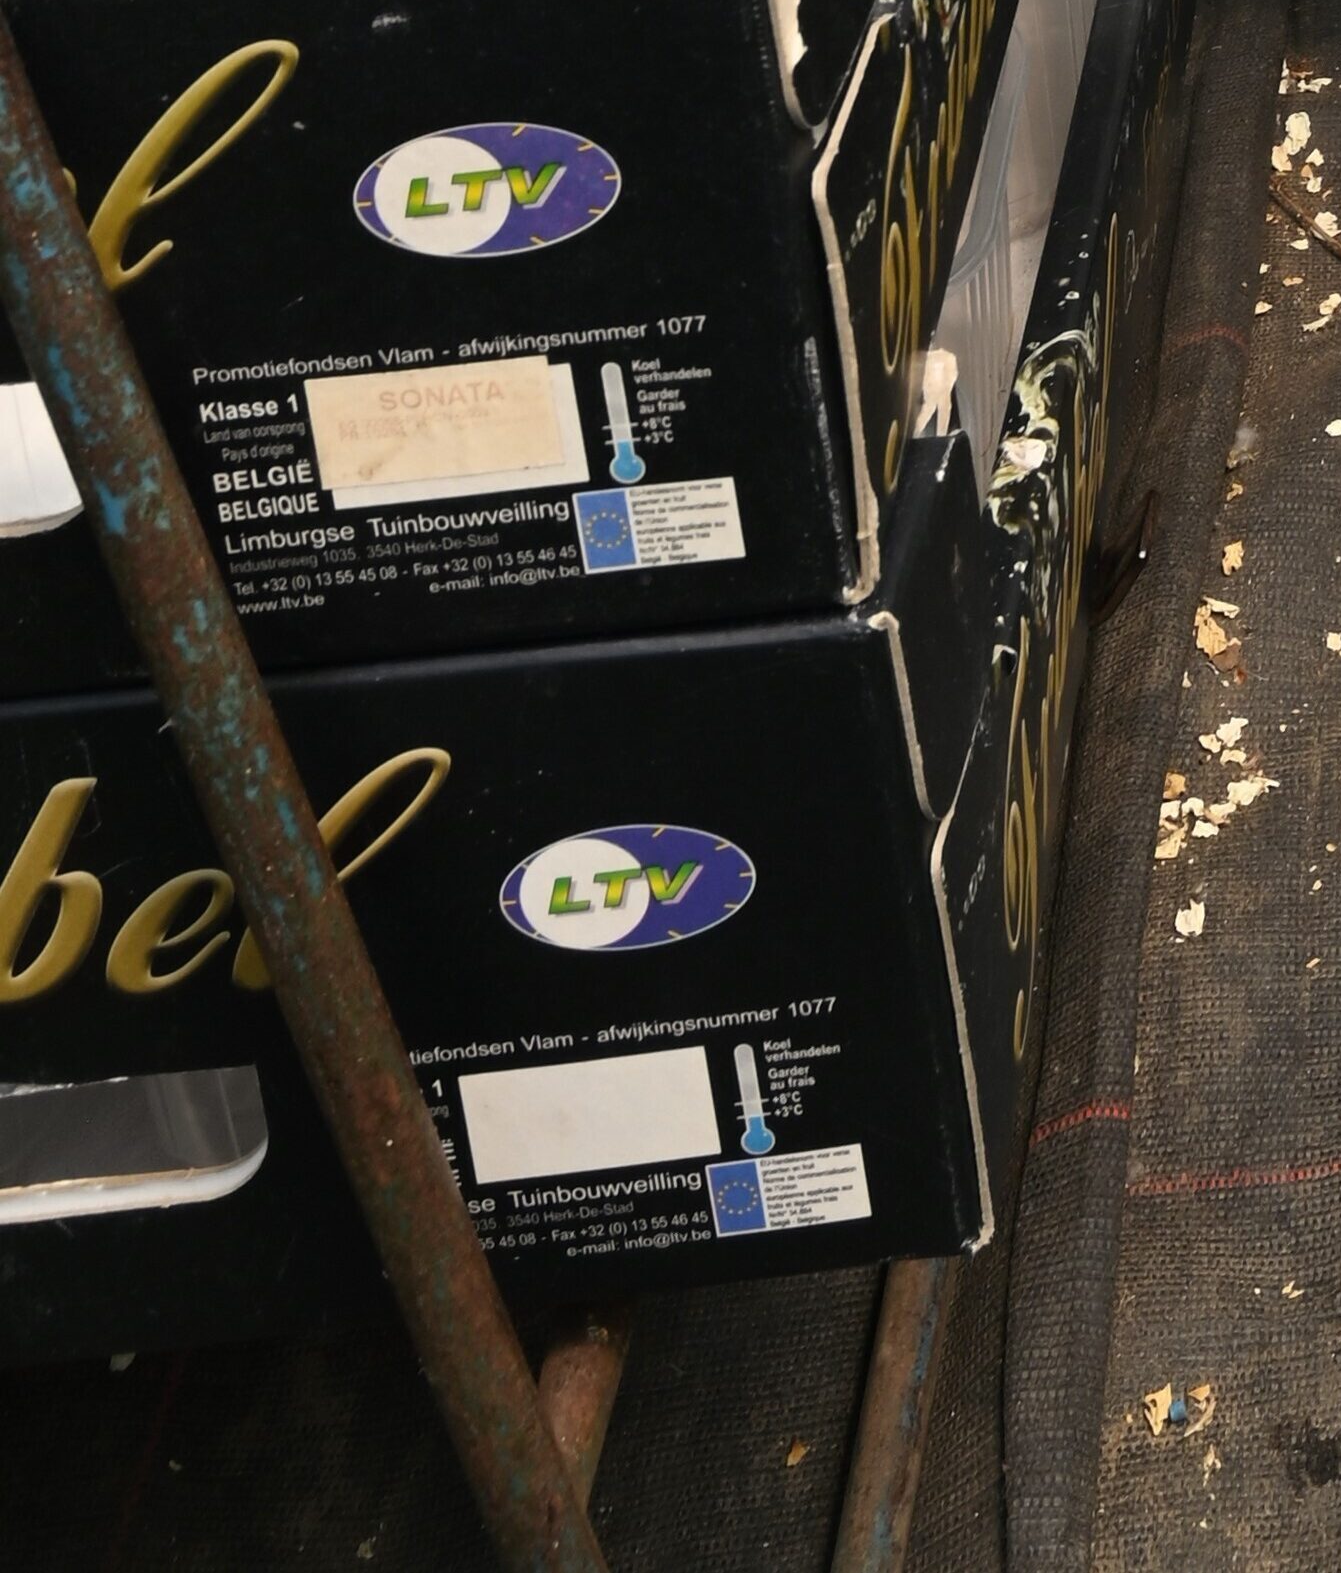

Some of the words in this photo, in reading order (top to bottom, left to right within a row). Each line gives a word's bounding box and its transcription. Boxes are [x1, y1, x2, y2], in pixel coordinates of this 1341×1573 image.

[405, 162, 567, 218] LTV
[192, 354, 373, 385] Promotiefondsen
[378, 347, 434, 366] Vlam
[458, 323, 648, 358] afwijkingsnummer
[656, 315, 706, 337] 1077
[631, 358, 660, 372] Koel
[634, 367, 712, 384] verhandelen
[199, 400, 279, 423] Klasse
[287, 393, 298, 413] 1
[379, 381, 505, 412] SONATA
[637, 388, 680, 402] Garder
[640, 404, 655, 414] au
[658, 400, 686, 412] frais
[203, 428, 230, 443] Land
[233, 429, 251, 439] van
[253, 422, 305, 437] oorsprong
[221, 447, 248, 463] Pays
[212, 458, 314, 493] BELGIË
[218, 492, 320, 523] BELGIQUE
[225, 525, 355, 555] Limburgse
[366, 500, 570, 538] Tuinbouwveilling
[230, 554, 318, 574] Industrieweg
[366, 542, 401, 559] 3540
[405, 532, 499, 554] Herk-De-Stad
[262, 578, 288, 592] +32
[292, 575, 311, 591] (0)
[316, 572, 332, 586] 13
[335, 569, 354, 585] 55
[358, 567, 376, 582] 45
[379, 565, 397, 580] 08
[413, 561, 438, 576] Fax
[443, 558, 468, 572] +32
[473, 555, 492, 571] (0)
[496, 553, 513, 567] 13
[517, 549, 534, 563] 55
[537, 547, 555, 561] 46
[559, 544, 577, 559] 45
[236, 594, 325, 615] www.ltv.be
[429, 575, 485, 593] e-mail:
[489, 565, 580, 586] info@ltv.be
[548, 860, 703, 915] LTV
[520, 1034, 574, 1052] Vlam
[597, 1006, 779, 1043] afwijkingsnummer
[788, 996, 837, 1019] 1077
[763, 1038, 791, 1052] Koel
[765, 1044, 841, 1063] verhandelen
[768, 1065, 809, 1079] Garder
[770, 1081, 785, 1090] au
[788, 1076, 815, 1088] frais
[507, 1171, 702, 1209] Tuinbouwveilling
[498, 1233, 516, 1247] 45
[518, 1232, 537, 1246] 08
[551, 1228, 576, 1242] Fax
[580, 1224, 605, 1238] +32
[608, 1221, 628, 1236] (0)
[632, 1219, 648, 1232] 13
[650, 1216, 668, 1229] 55
[671, 1213, 688, 1226] 46
[691, 1210, 709, 1224] 45
[506, 1212, 540, 1228] 3540
[543, 1201, 635, 1223] Herk-De-Stad
[566, 1240, 620, 1257] e-mail:
[624, 1229, 712, 1249] info@ltv.be
